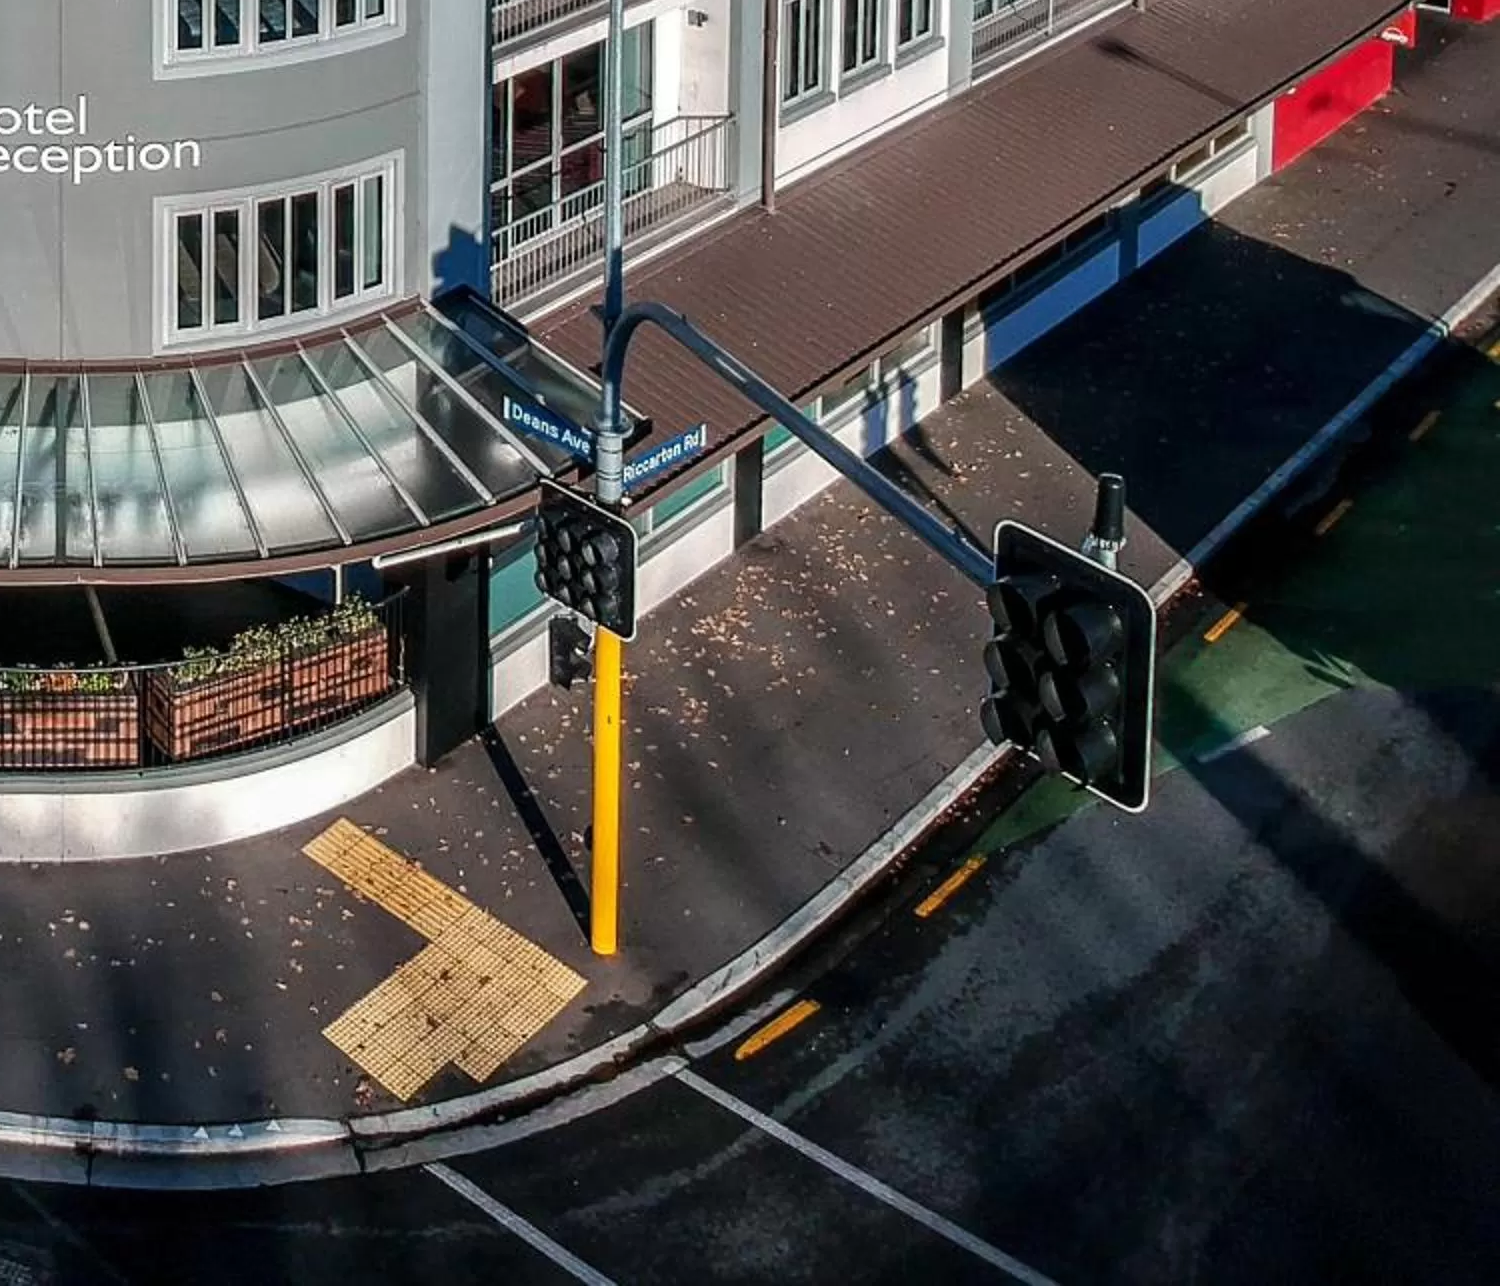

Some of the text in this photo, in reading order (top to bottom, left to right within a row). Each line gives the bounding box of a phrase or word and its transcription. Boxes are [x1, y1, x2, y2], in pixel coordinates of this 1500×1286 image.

[511, 403, 592, 455] Deans Ave
[623, 429, 701, 483] Riccarton Rd
